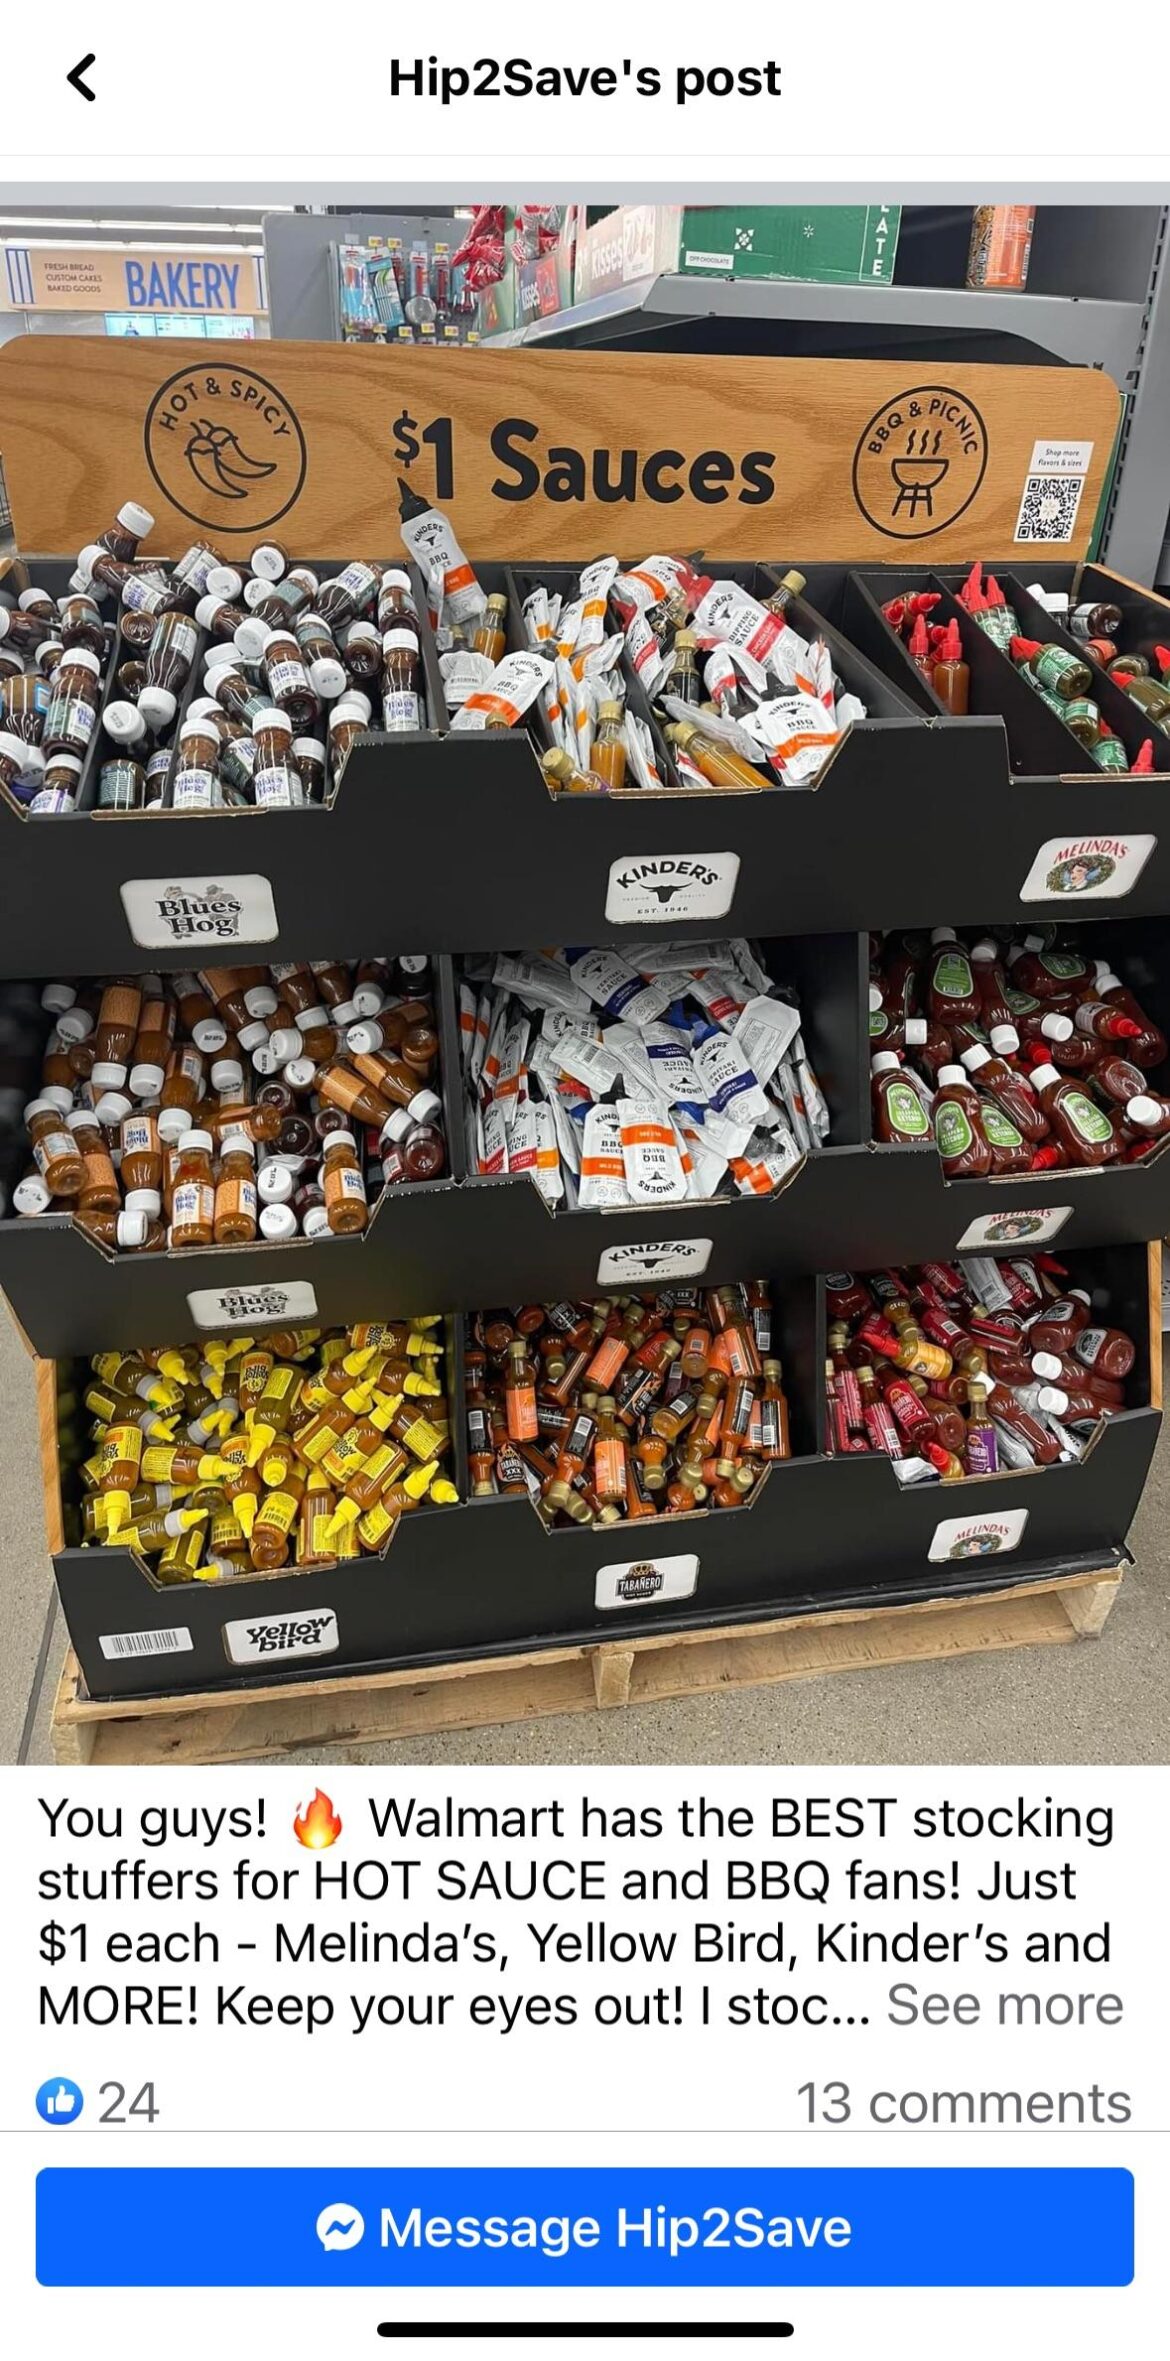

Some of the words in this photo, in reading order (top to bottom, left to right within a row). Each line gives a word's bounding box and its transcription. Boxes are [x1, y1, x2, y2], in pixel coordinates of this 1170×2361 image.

[44, 263, 68, 271] FRESH
[70, 264, 94, 272] BREAD
[46, 274, 77, 283] CUSTOM
[79, 275, 103, 283] CAKES
[48, 284, 72, 293] BAKED
[74, 285, 101, 293] GOODS
[125, 260, 240, 309] BAKERY
[159, 382, 198, 431] HOT
[206, 377, 221, 395] &
[230, 380, 291, 435] SPICY
[868, 412, 904, 454] BBQ
[909, 401, 922, 418] &
[929, 399, 978, 455] PICNIC
[393, 409, 454, 500] $1
[490, 417, 777, 504] Sauces
[1038, 458, 1060, 466] flavors
[1046, 448, 1065, 457] Shop
[429, 552, 449, 566] BBQ
[728, 609, 753, 643] DIPPING
[734, 613, 760, 647] SAUCE
[616, 860, 719, 889] KINDER'S
[155, 898, 241, 917] Blues
[169, 916, 234, 937] Hog
[217, 1294, 289, 1308] Blues
[227, 1305, 280, 1316] Hog
[620, 1577, 661, 1592] TABAÑERO
[246, 1616, 335, 1644] Yellow
[258, 1628, 322, 1652] bird
